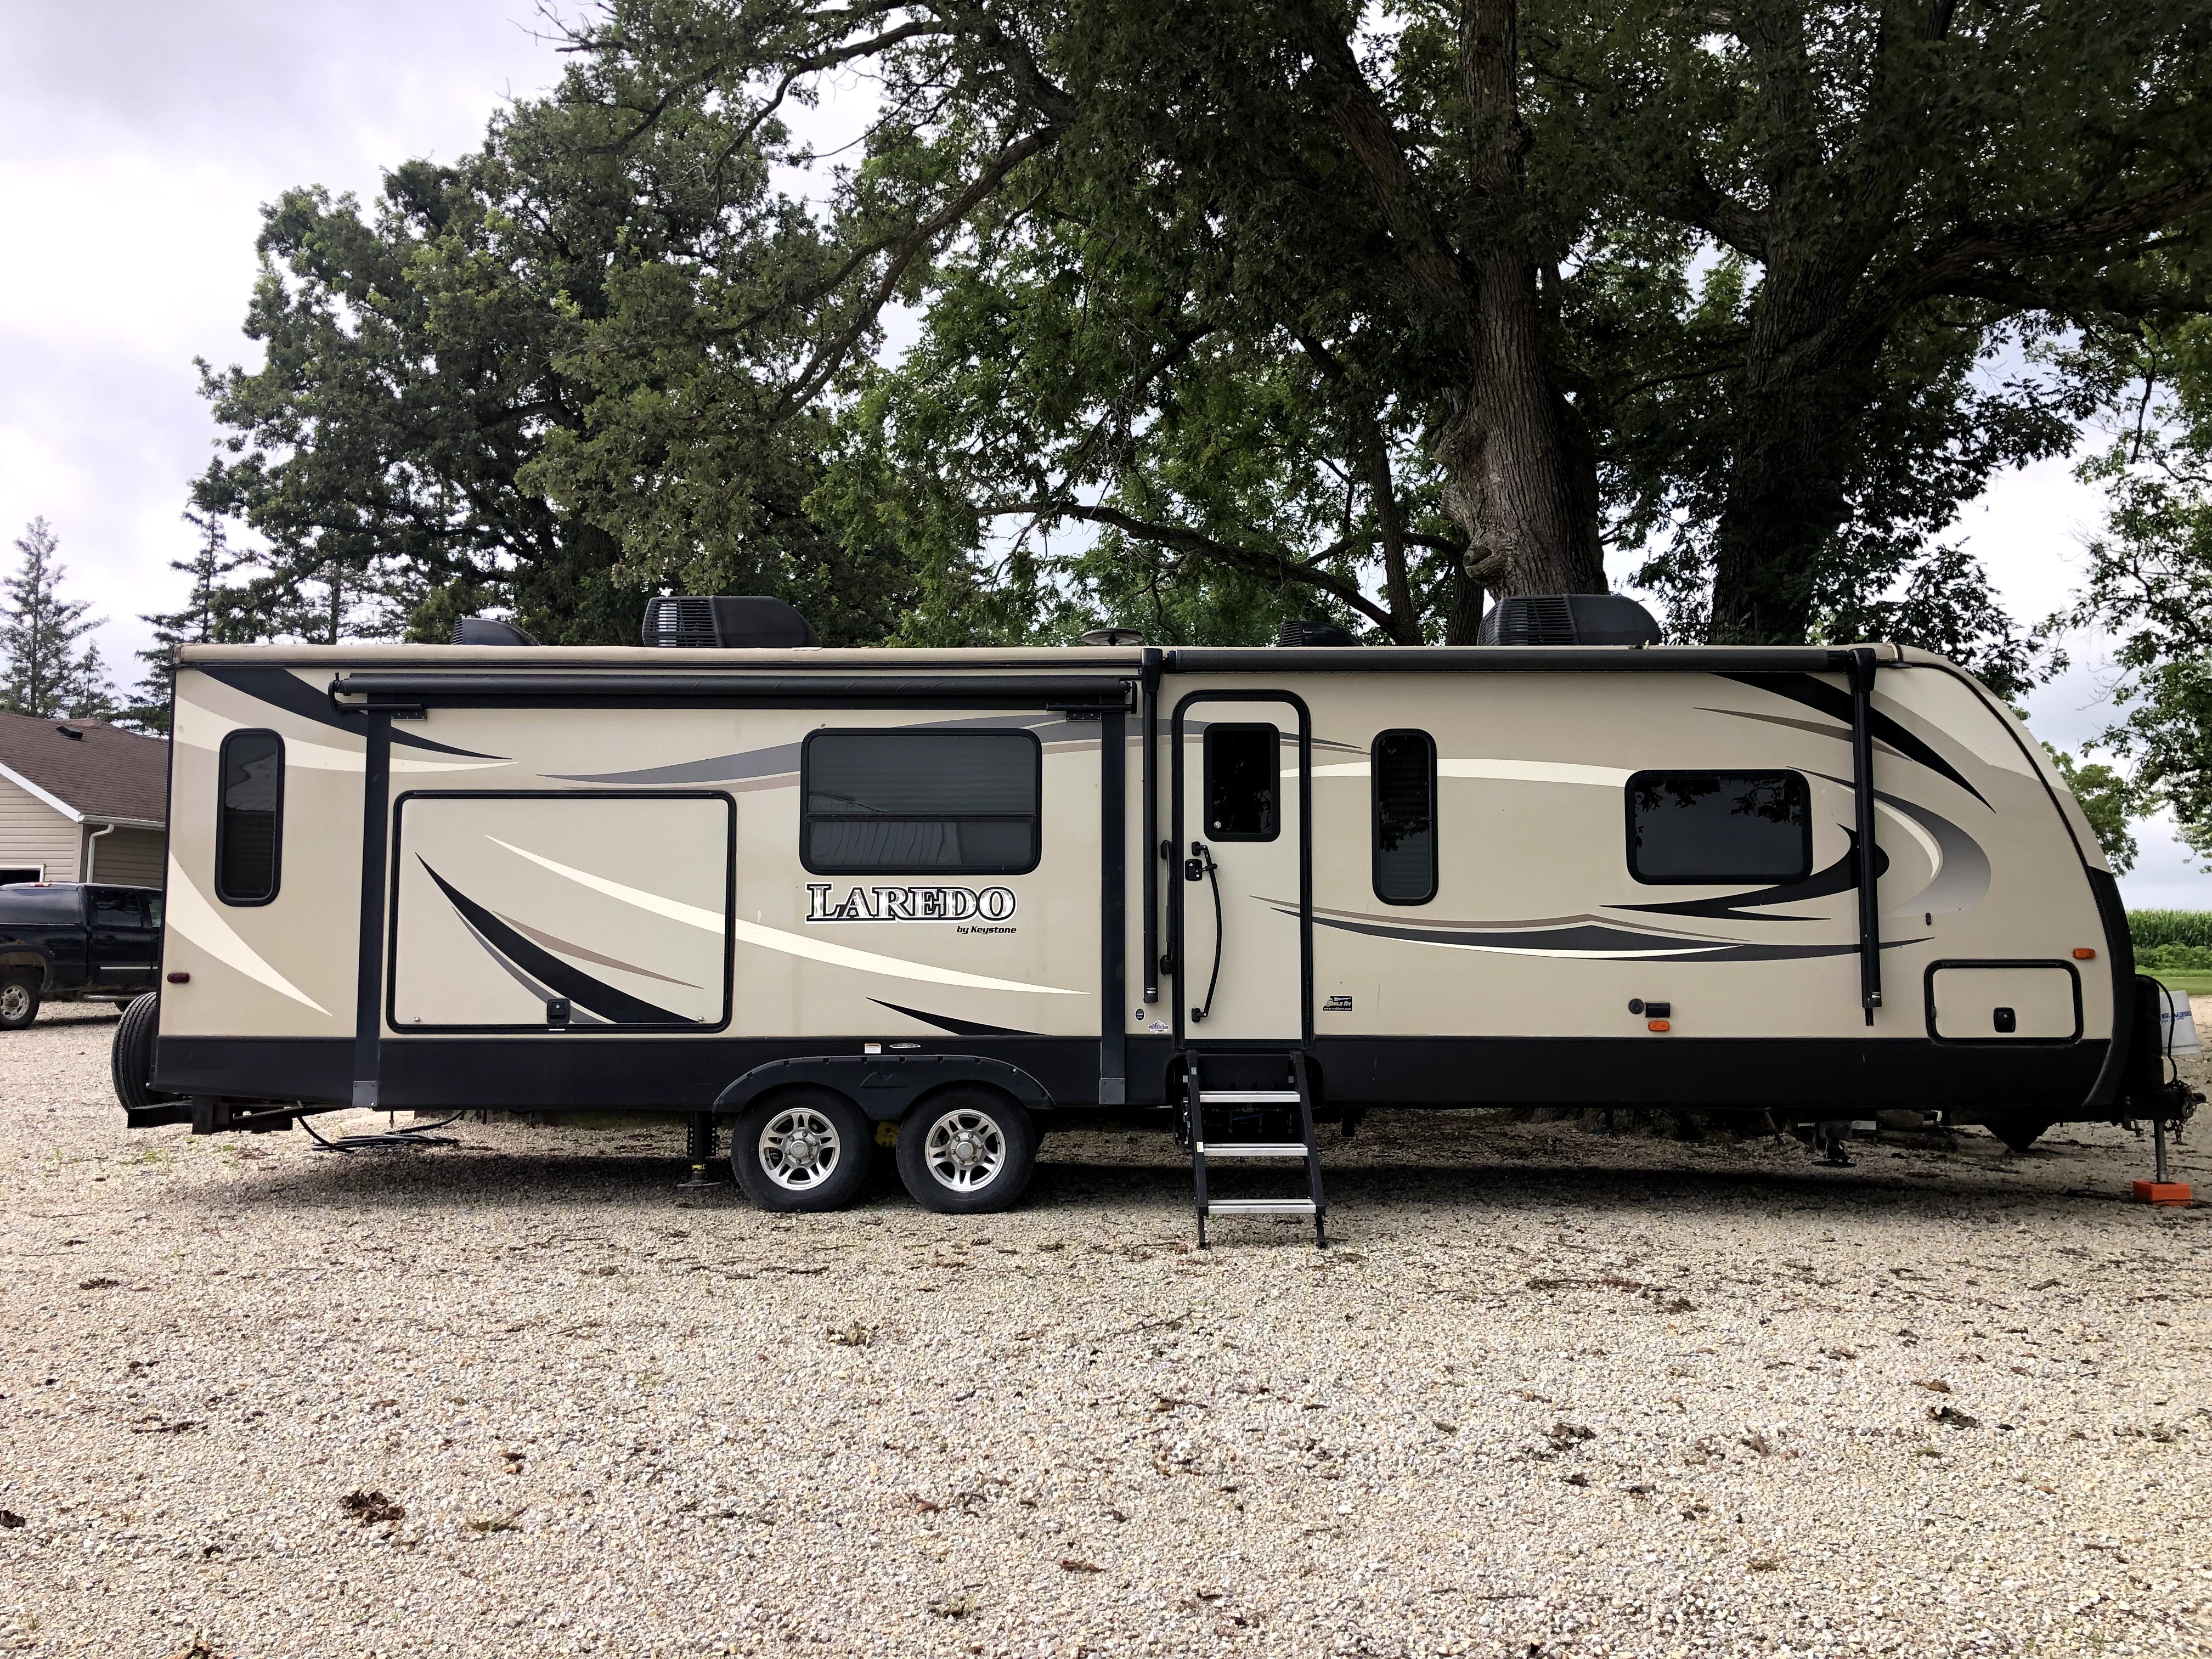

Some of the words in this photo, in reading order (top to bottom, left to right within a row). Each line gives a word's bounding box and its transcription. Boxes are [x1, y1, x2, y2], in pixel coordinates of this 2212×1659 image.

[805, 882, 1017, 923] LAREDO
[956, 926, 969, 935] by
[970, 926, 1017, 935] Keystone
